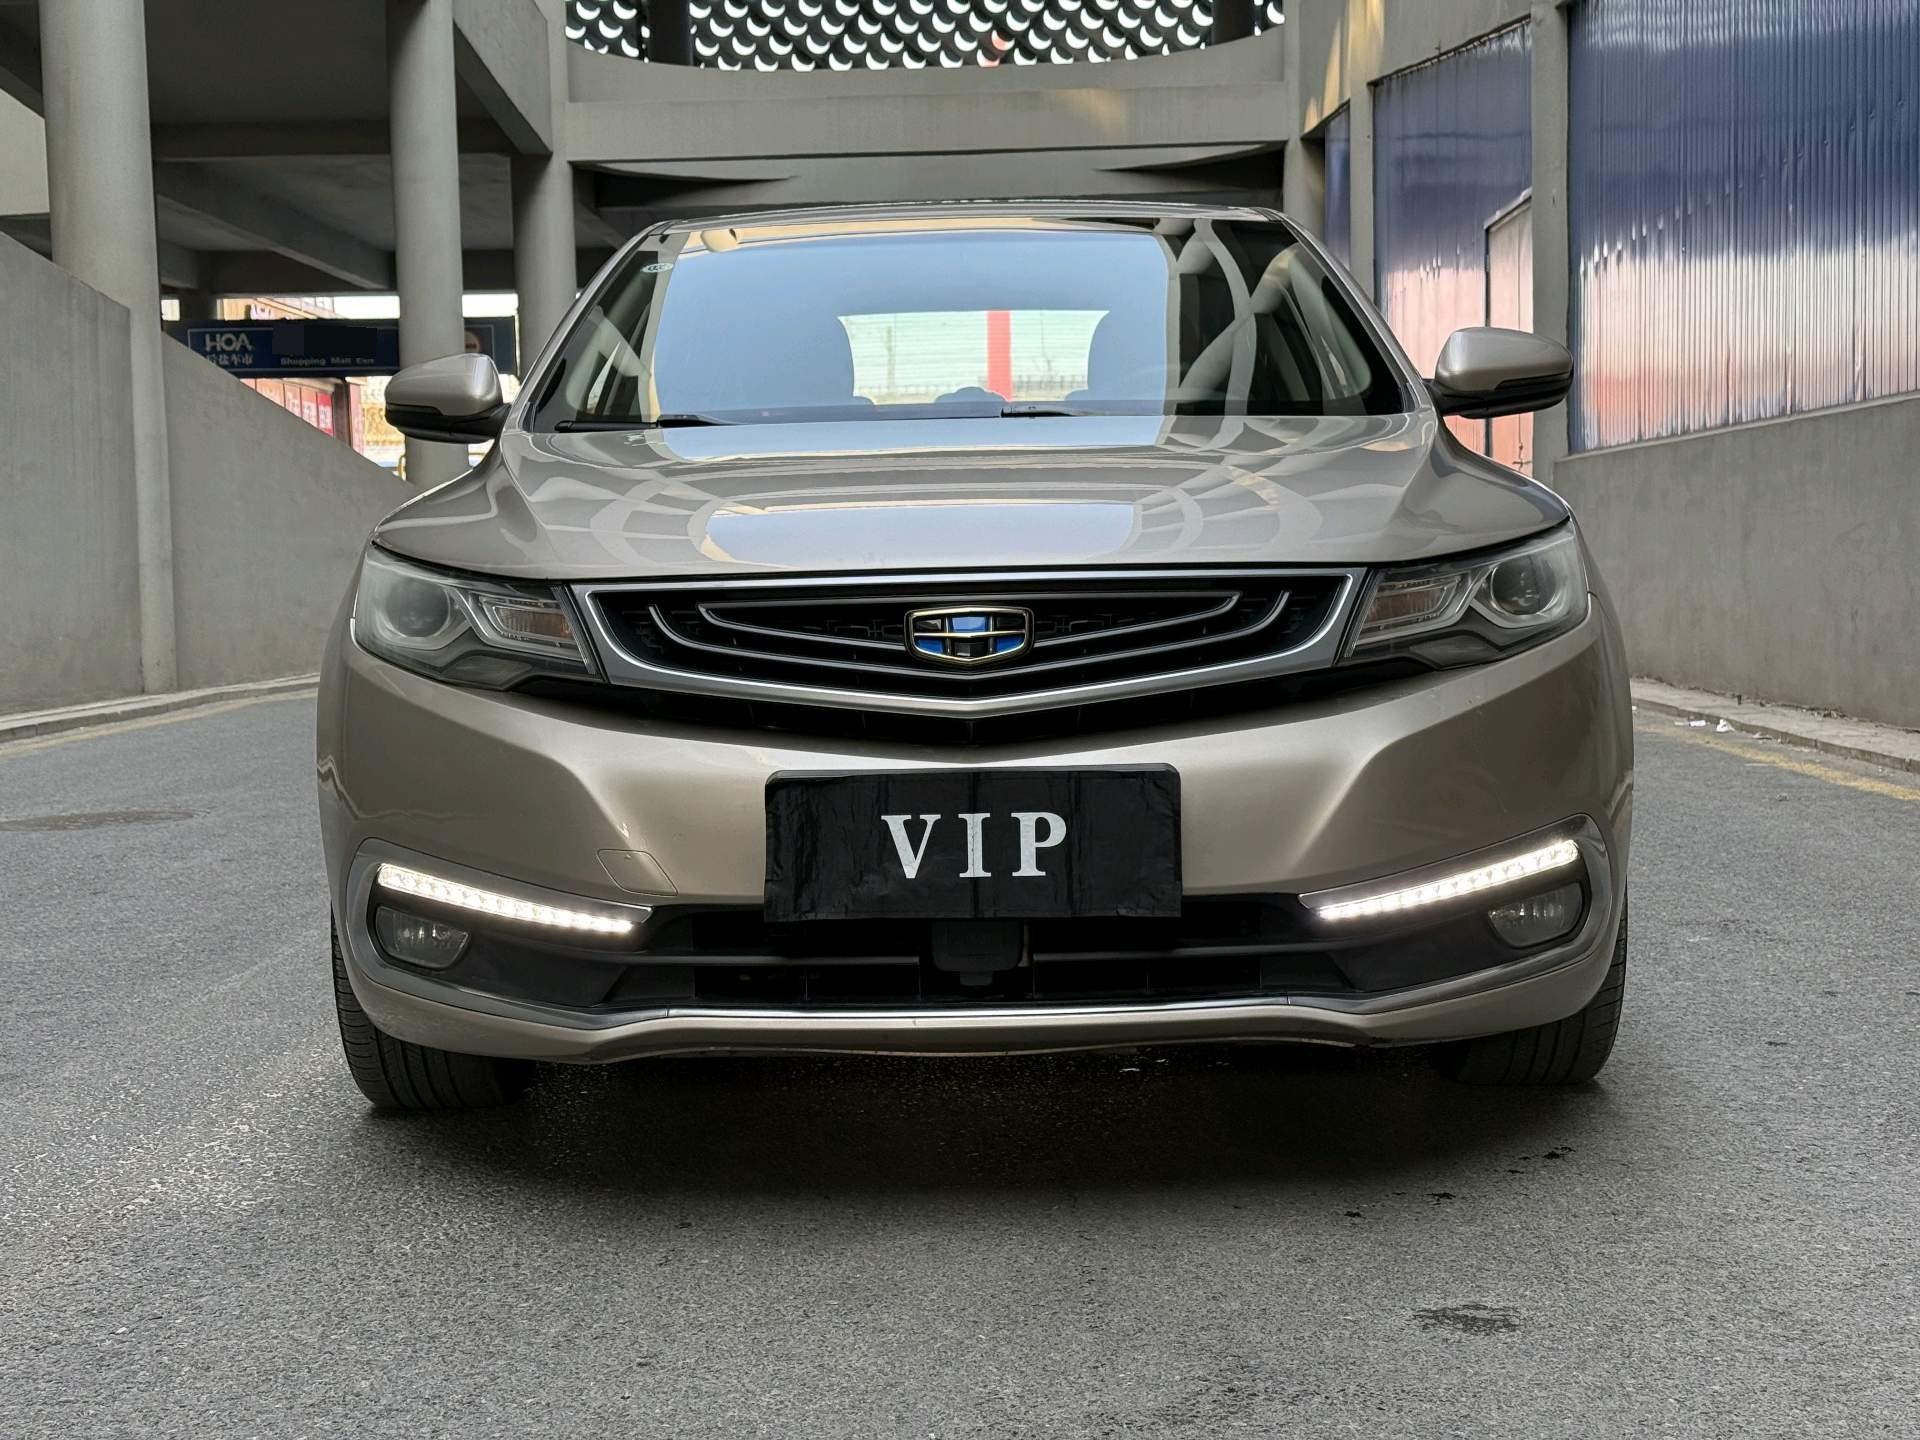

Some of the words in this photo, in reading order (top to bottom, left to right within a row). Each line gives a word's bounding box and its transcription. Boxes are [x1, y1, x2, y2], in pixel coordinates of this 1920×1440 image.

[205, 333, 253, 351] HOA
[280, 356, 326, 366] Shopping
[881, 812, 1067, 879] VIP
